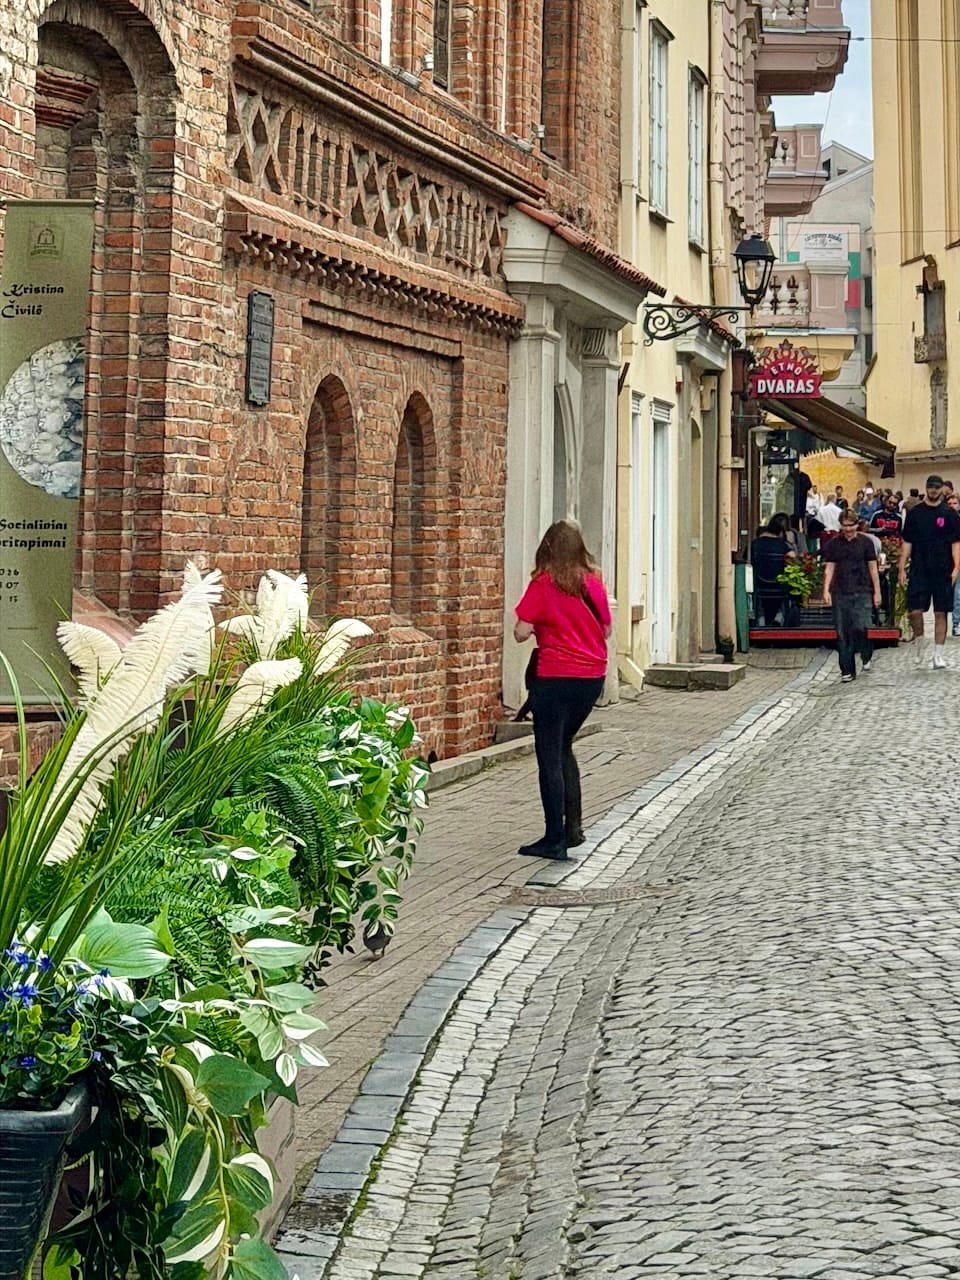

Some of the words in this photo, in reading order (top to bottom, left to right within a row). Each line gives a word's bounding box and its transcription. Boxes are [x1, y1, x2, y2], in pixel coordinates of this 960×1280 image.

[3, 284, 64, 297] Kristina
[771, 362, 802, 375] ETNO
[757, 379, 814, 393] DVARAS
[0, 537, 66, 551] ritapimai
